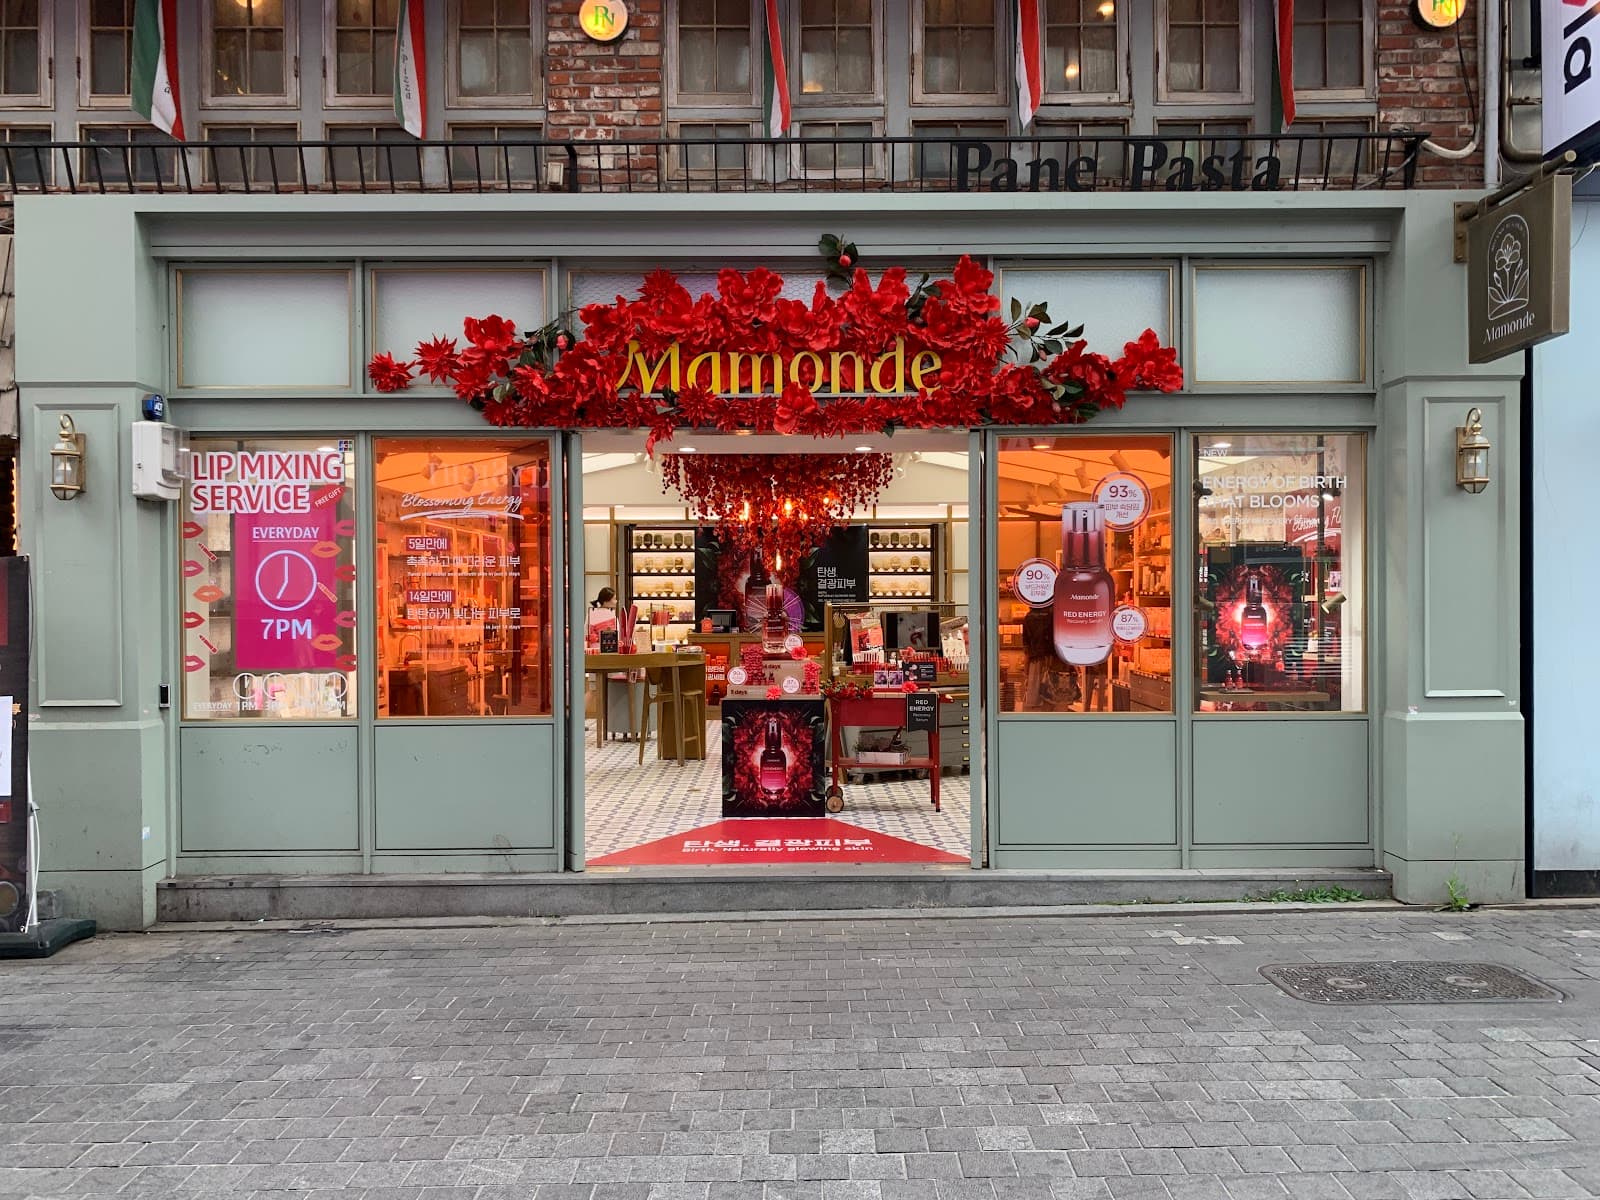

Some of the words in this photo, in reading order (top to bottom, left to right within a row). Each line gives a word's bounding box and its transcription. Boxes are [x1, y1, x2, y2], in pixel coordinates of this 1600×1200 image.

[953, 141, 1097, 192] Pane
[1127, 141, 1282, 192] Pasta
[1483, 310, 1536, 344] Mamonde
[615, 336, 942, 394] Mamonde
[1203, 449, 1227, 457] NEW
[192, 453, 233, 480] LIP
[239, 453, 343, 480] MIXING
[1202, 475, 1269, 489] ENERGY
[1273, 475, 1296, 489] OF
[1299, 475, 1347, 489] BIRTH
[191, 484, 309, 511] SERVICE
[314, 496, 329, 508] FREE
[328, 487, 342, 499] GIFT
[1109, 485, 1138, 498] 93%
[401, 493, 474, 513] Blossoming
[478, 491, 523, 513] Energy
[1250, 494, 1320, 508] BLOOMS
[252, 527, 319, 539] EVERYDAY
[408, 537, 448, 550] 5일만에
[1026, 570, 1050, 580] 90%
[409, 590, 452, 603] 14일만에
[1063, 610, 1078, 618] RED
[1078, 610, 1107, 618] ENERGY
[260, 618, 313, 640] 7PM
